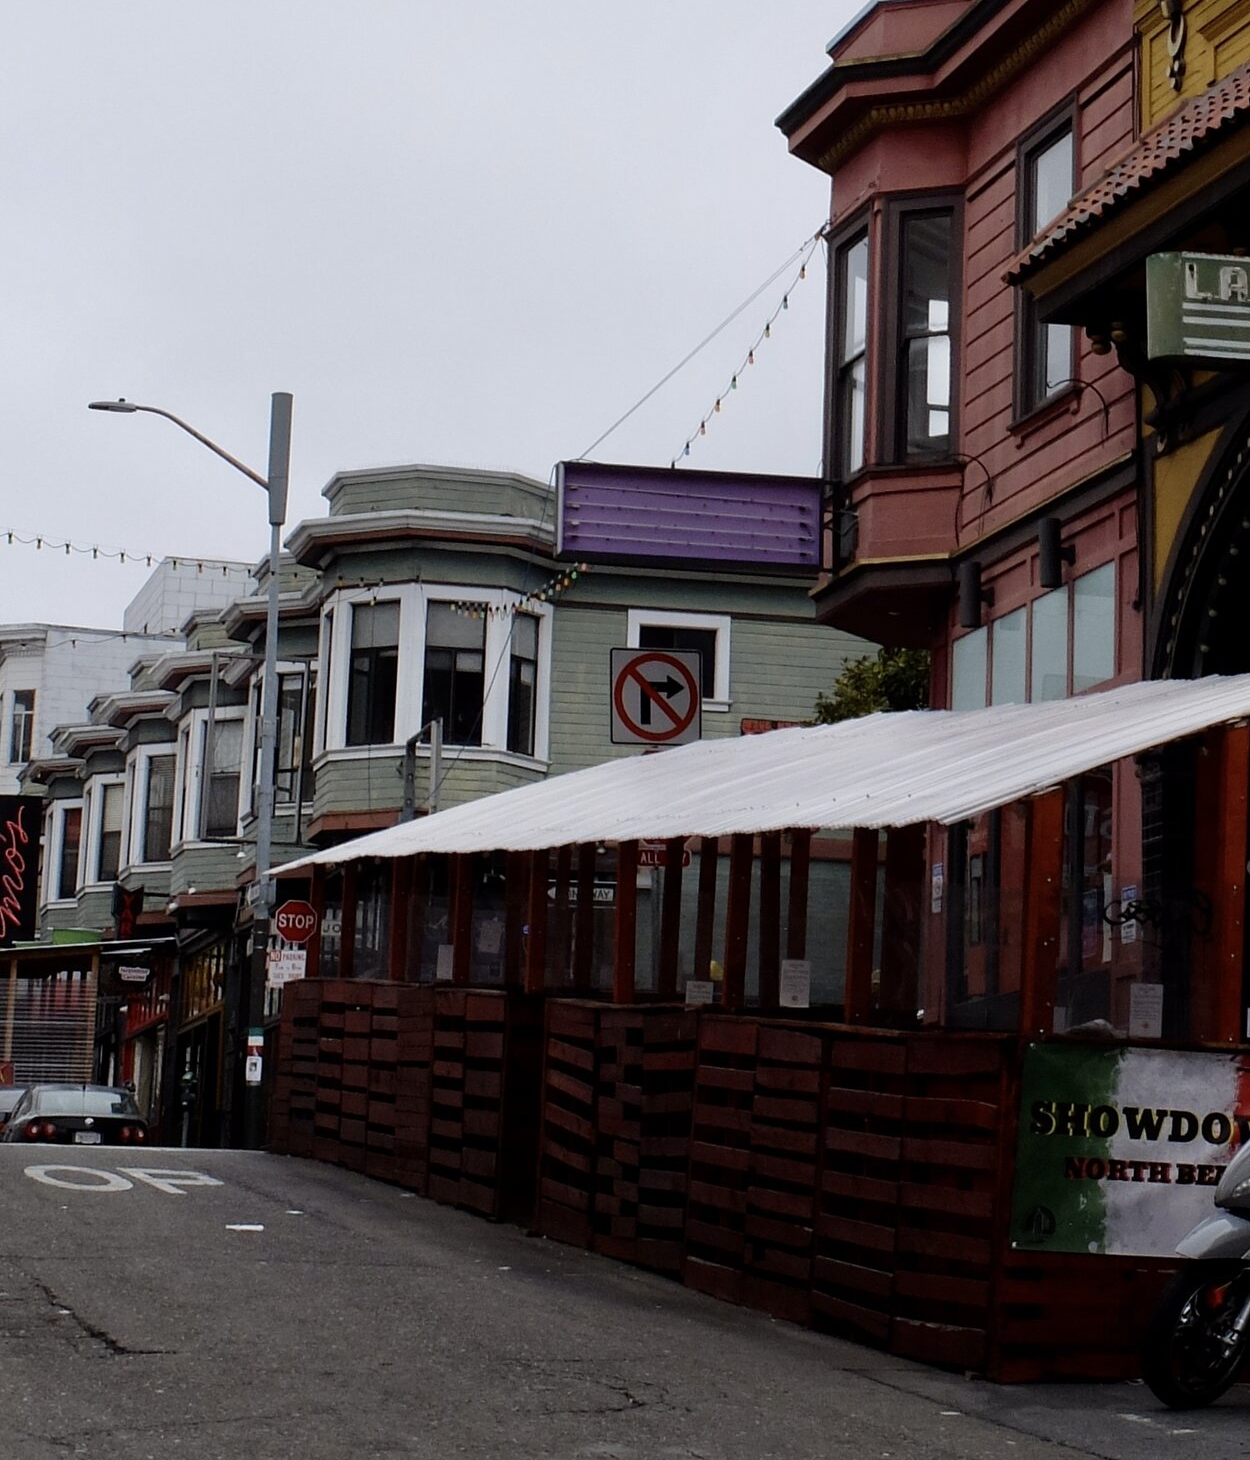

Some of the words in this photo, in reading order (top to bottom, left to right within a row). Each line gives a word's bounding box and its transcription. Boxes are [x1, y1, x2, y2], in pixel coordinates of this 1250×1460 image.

[1185, 262, 1248, 302] LA
[640, 851, 661, 864] ALL
[278, 913, 315, 929] STOP
[270, 951, 281, 960] NO
[1064, 1156, 1172, 1184] NORTH
